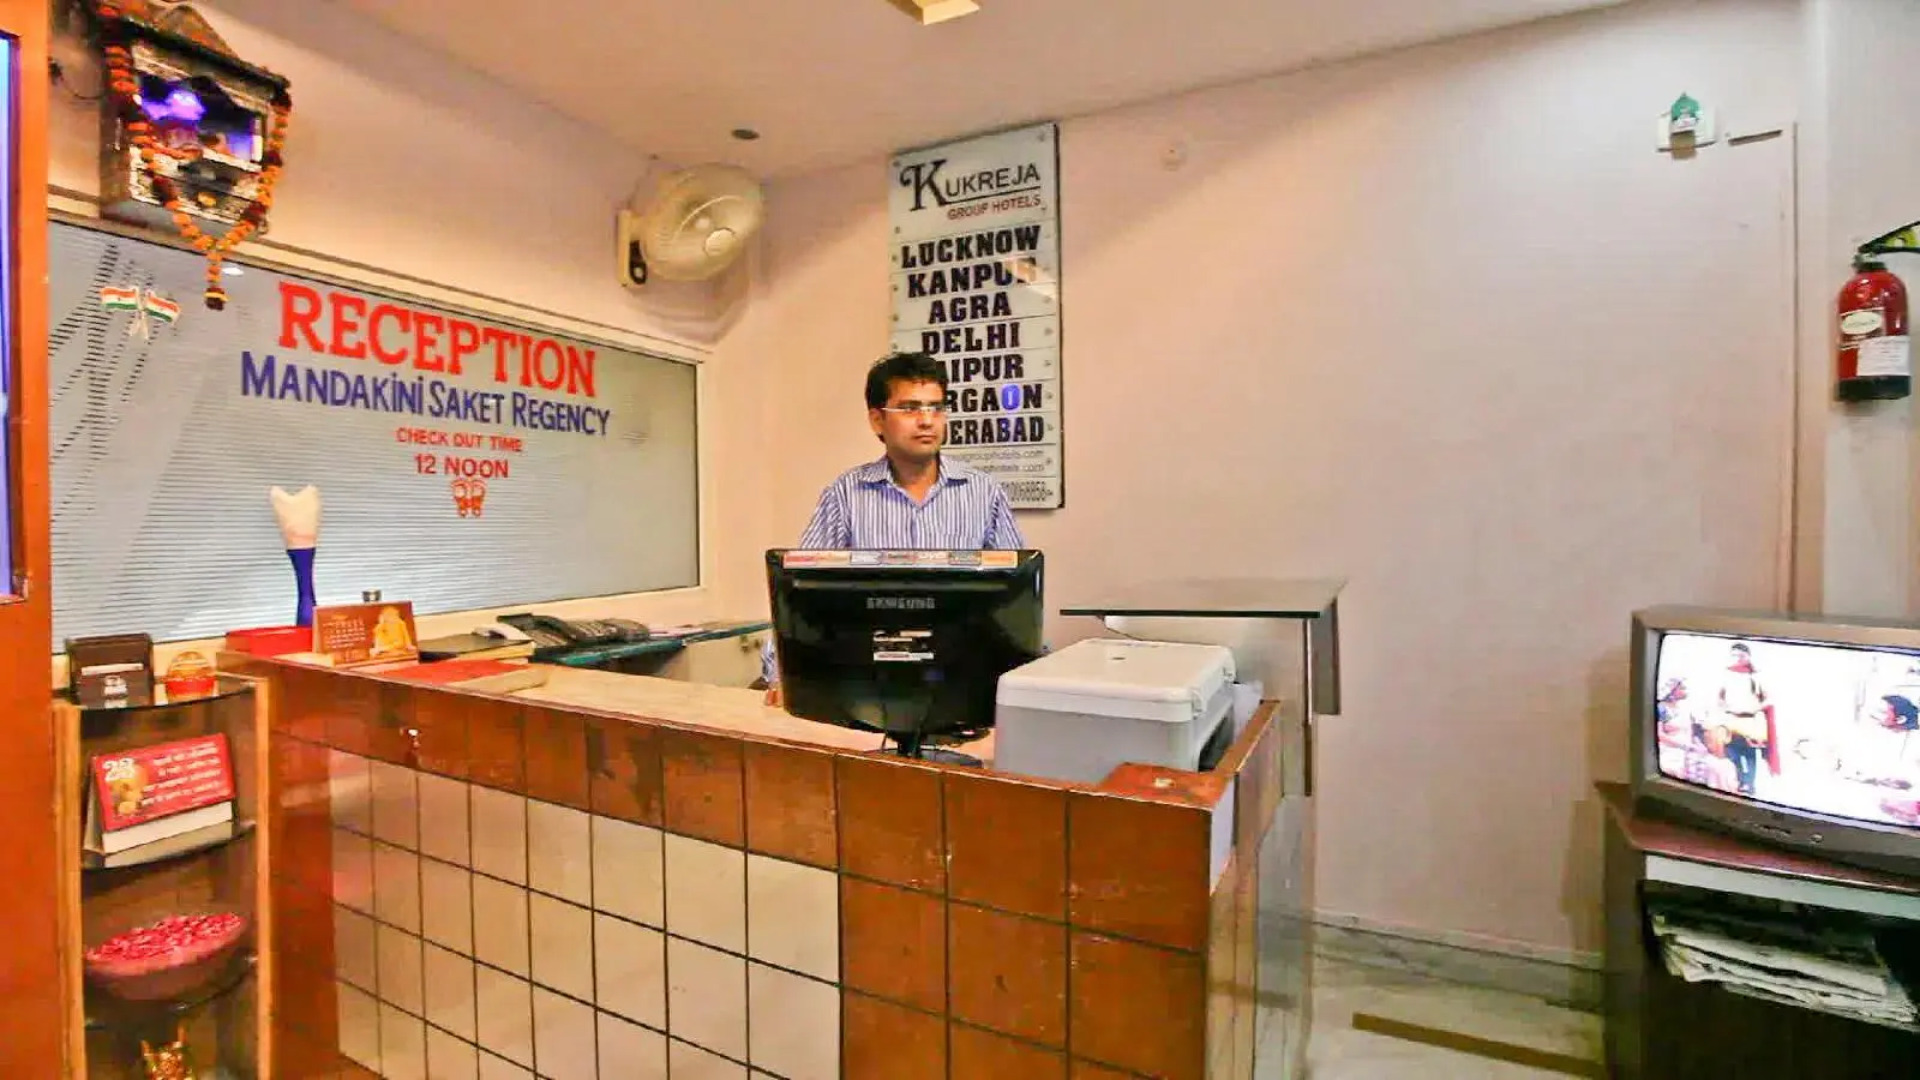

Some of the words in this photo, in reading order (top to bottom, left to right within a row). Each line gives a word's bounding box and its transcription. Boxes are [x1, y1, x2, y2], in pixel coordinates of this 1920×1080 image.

[900, 159, 1041, 212] KUKREJA
[947, 202, 989, 220] GROUP
[993, 193, 1041, 211] HOTELS
[901, 225, 1041, 269] LUCKNOW
[929, 291, 1012, 326] AGRA
[278, 281, 596, 397] RECEPTION
[922, 322, 1020, 355] DELHI
[936, 354, 1024, 384] AIPUR
[428, 381, 505, 424] SAKET
[512, 391, 610, 436] REGENCY
[942, 384, 1042, 413] RGAON
[395, 427, 449, 446] CHECK
[452, 433, 483, 448] OUT
[489, 436, 523, 452] TIME
[942, 416, 1044, 446] ERABAD
[414, 453, 437, 474] 12
[444, 456, 509, 478] NOON
